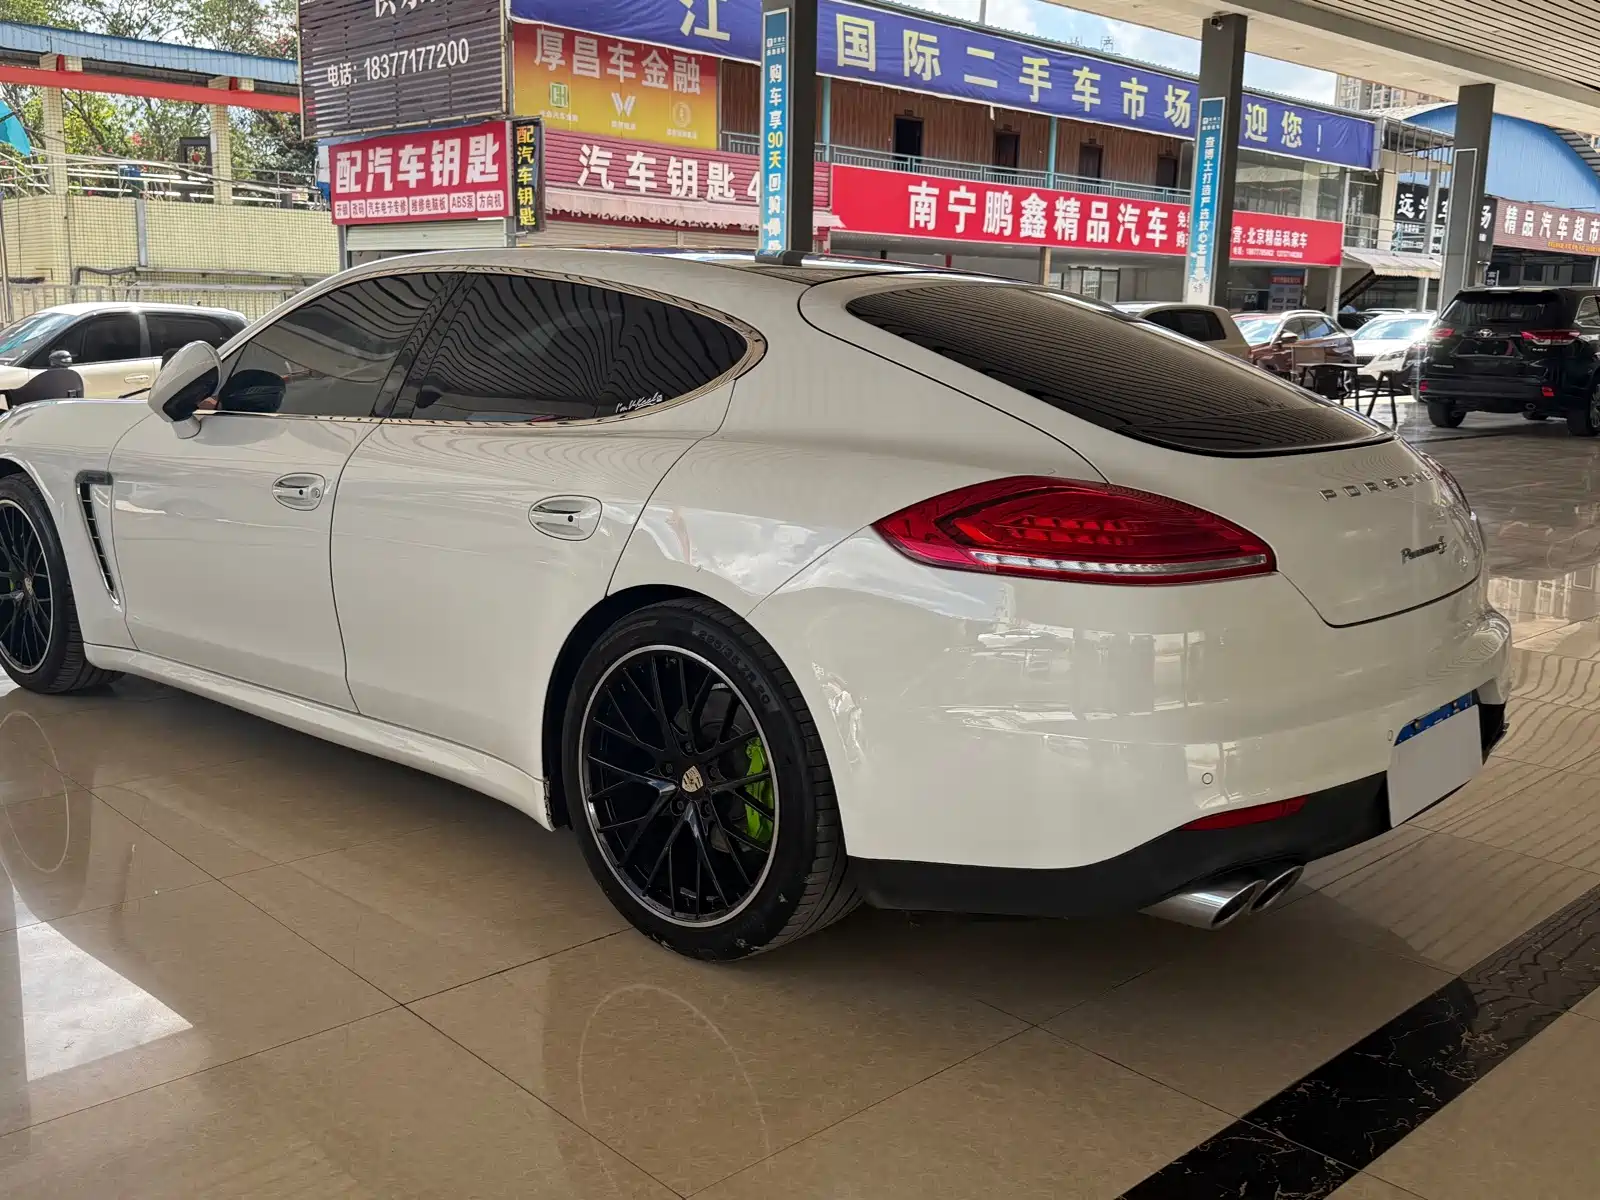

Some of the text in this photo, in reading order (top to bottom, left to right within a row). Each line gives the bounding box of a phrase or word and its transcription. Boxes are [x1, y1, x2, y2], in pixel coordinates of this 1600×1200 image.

[534, 28, 701, 95] 厚昌车金融
[835, 13, 1193, 130] 国际二手车市场
[335, 133, 500, 194] 配汽车钥匙
[516, 125, 536, 226] 配汽车钥匙
[908, 180, 1169, 248] 南宁鹏鑫精品汽车
[1504, 205, 1600, 244] 精品汽车超市
[1319, 470, 1433, 501] PORSCHE
